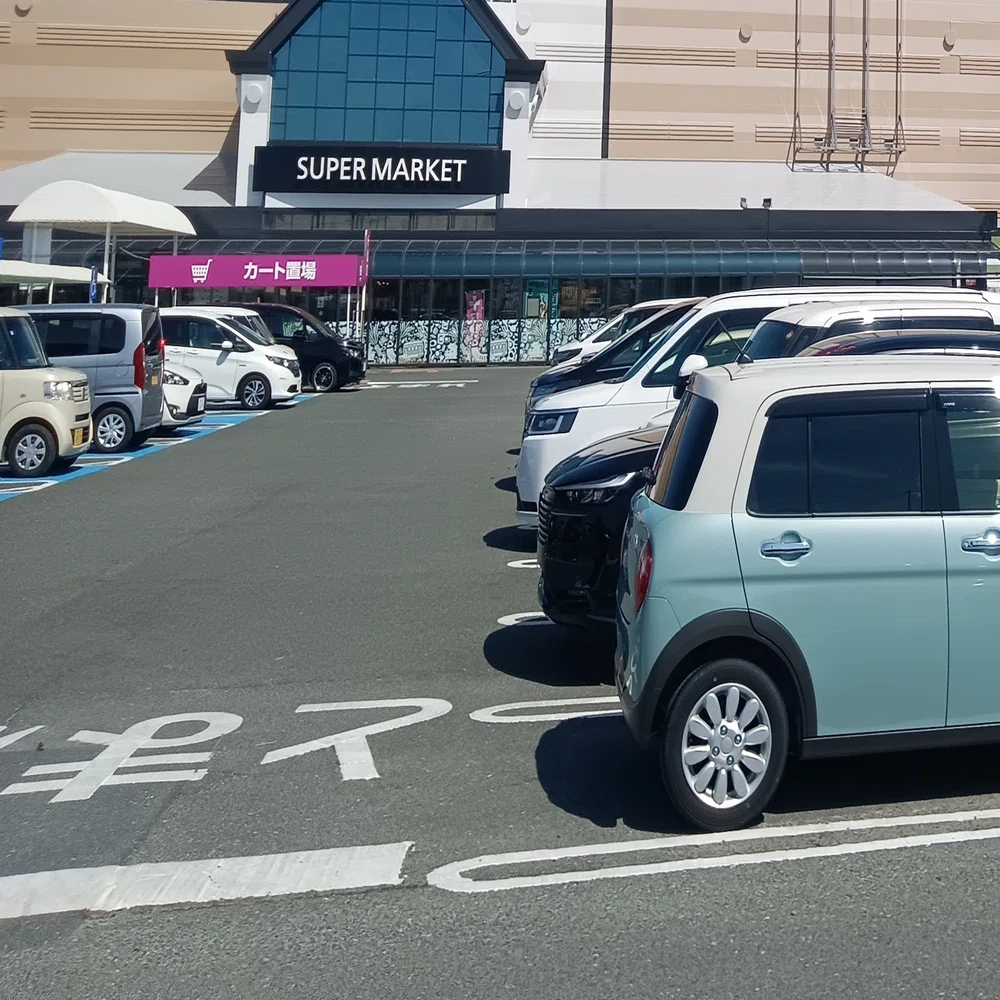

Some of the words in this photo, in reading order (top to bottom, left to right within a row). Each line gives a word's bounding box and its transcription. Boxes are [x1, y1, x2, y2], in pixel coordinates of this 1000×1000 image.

[297, 157, 366, 180] SUPER
[371, 157, 467, 182] MARKET
[243, 261, 316, 280] カート置場
